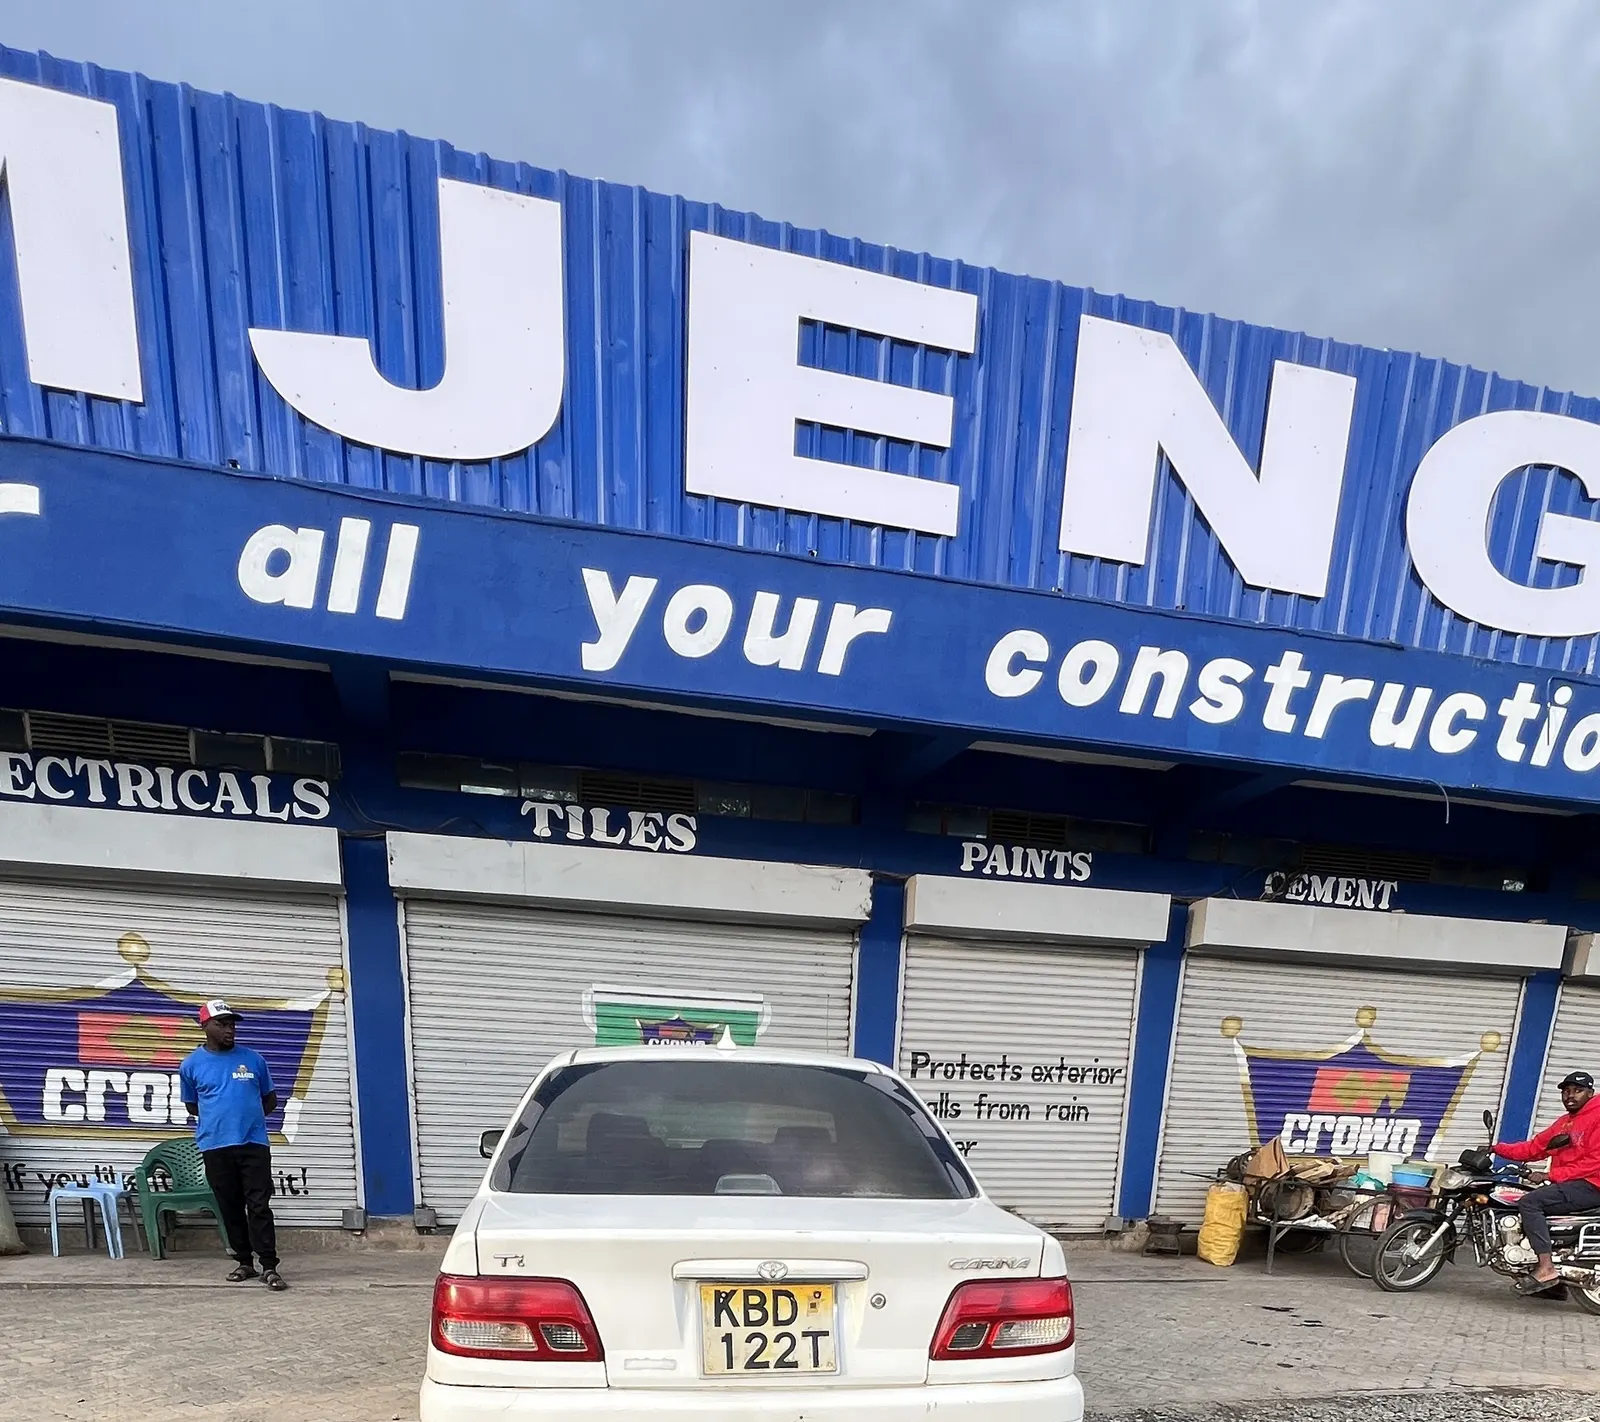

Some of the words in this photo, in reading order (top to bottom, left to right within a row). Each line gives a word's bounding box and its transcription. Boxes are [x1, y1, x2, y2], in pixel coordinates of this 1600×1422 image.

[237, 517, 419, 620] all
[581, 567, 893, 676] your
[0, 752, 330, 820] ECTRICALS
[521, 800, 698, 852] TILES
[960, 841, 1093, 881] PAINTS
[910, 1051, 1023, 1082] Protects
[1031, 1056, 1122, 1085] exterior
[925, 1092, 962, 1119] alls
[974, 1093, 1030, 1120] from
[1045, 1096, 1089, 1121] rain
[4, 1163, 26, 1191] If
[949, 1257, 1031, 1270] CARINA
[714, 1289, 799, 1328] KBD
[721, 1330, 830, 1370] 122T
